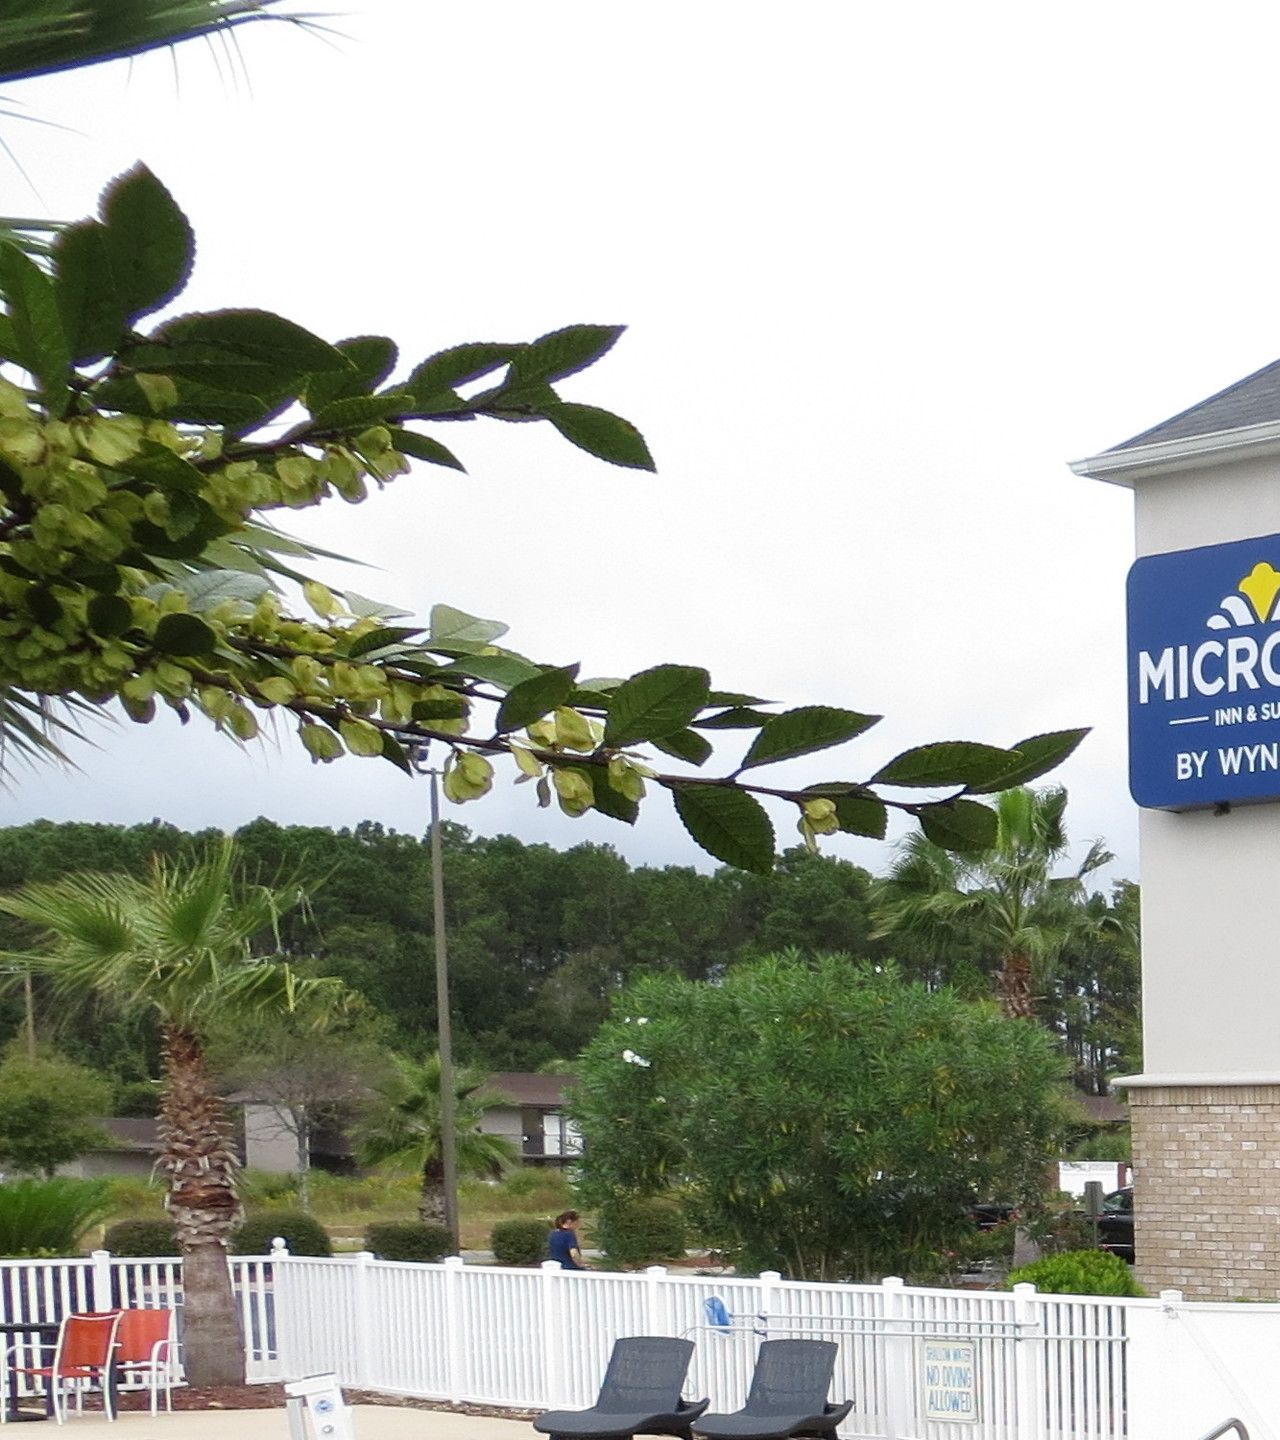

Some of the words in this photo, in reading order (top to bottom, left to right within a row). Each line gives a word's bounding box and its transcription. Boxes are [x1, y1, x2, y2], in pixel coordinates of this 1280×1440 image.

[1215, 706, 1242, 726] INN
[1246, 704, 1257, 721] &
[1176, 750, 1208, 780] BY
[926, 1365, 940, 1386] NO
[942, 1366, 972, 1388] DIVING
[928, 1390, 972, 1412] ALLOWED
